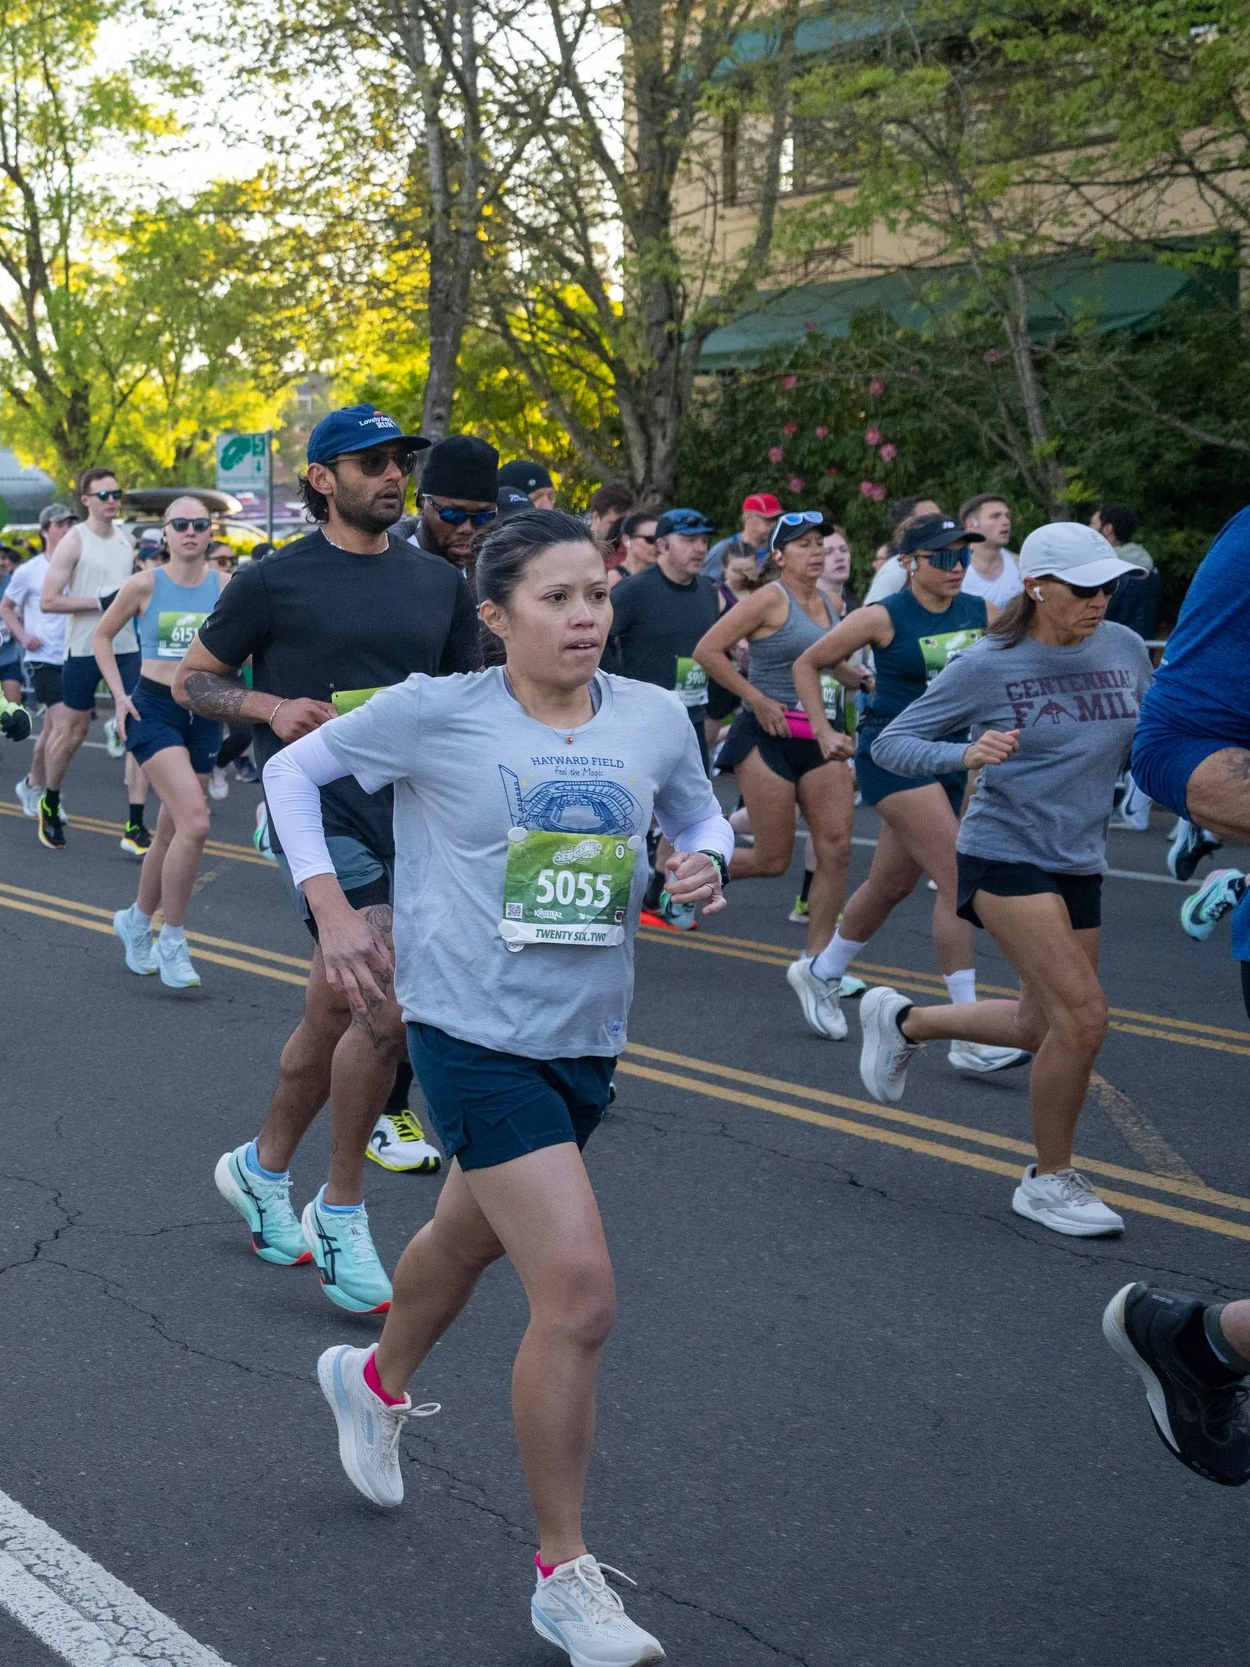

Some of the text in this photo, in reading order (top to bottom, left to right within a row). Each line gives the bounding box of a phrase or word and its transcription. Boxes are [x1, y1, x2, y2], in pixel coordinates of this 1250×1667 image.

[359, 416, 381, 426] Lovely
[255, 435, 263, 452] 5
[531, 756, 624, 768] HAYWARD FIELD
[555, 766, 604, 779] Feel the Magic
[536, 869, 612, 908] 5055
[535, 929, 572, 940] TWENTY
